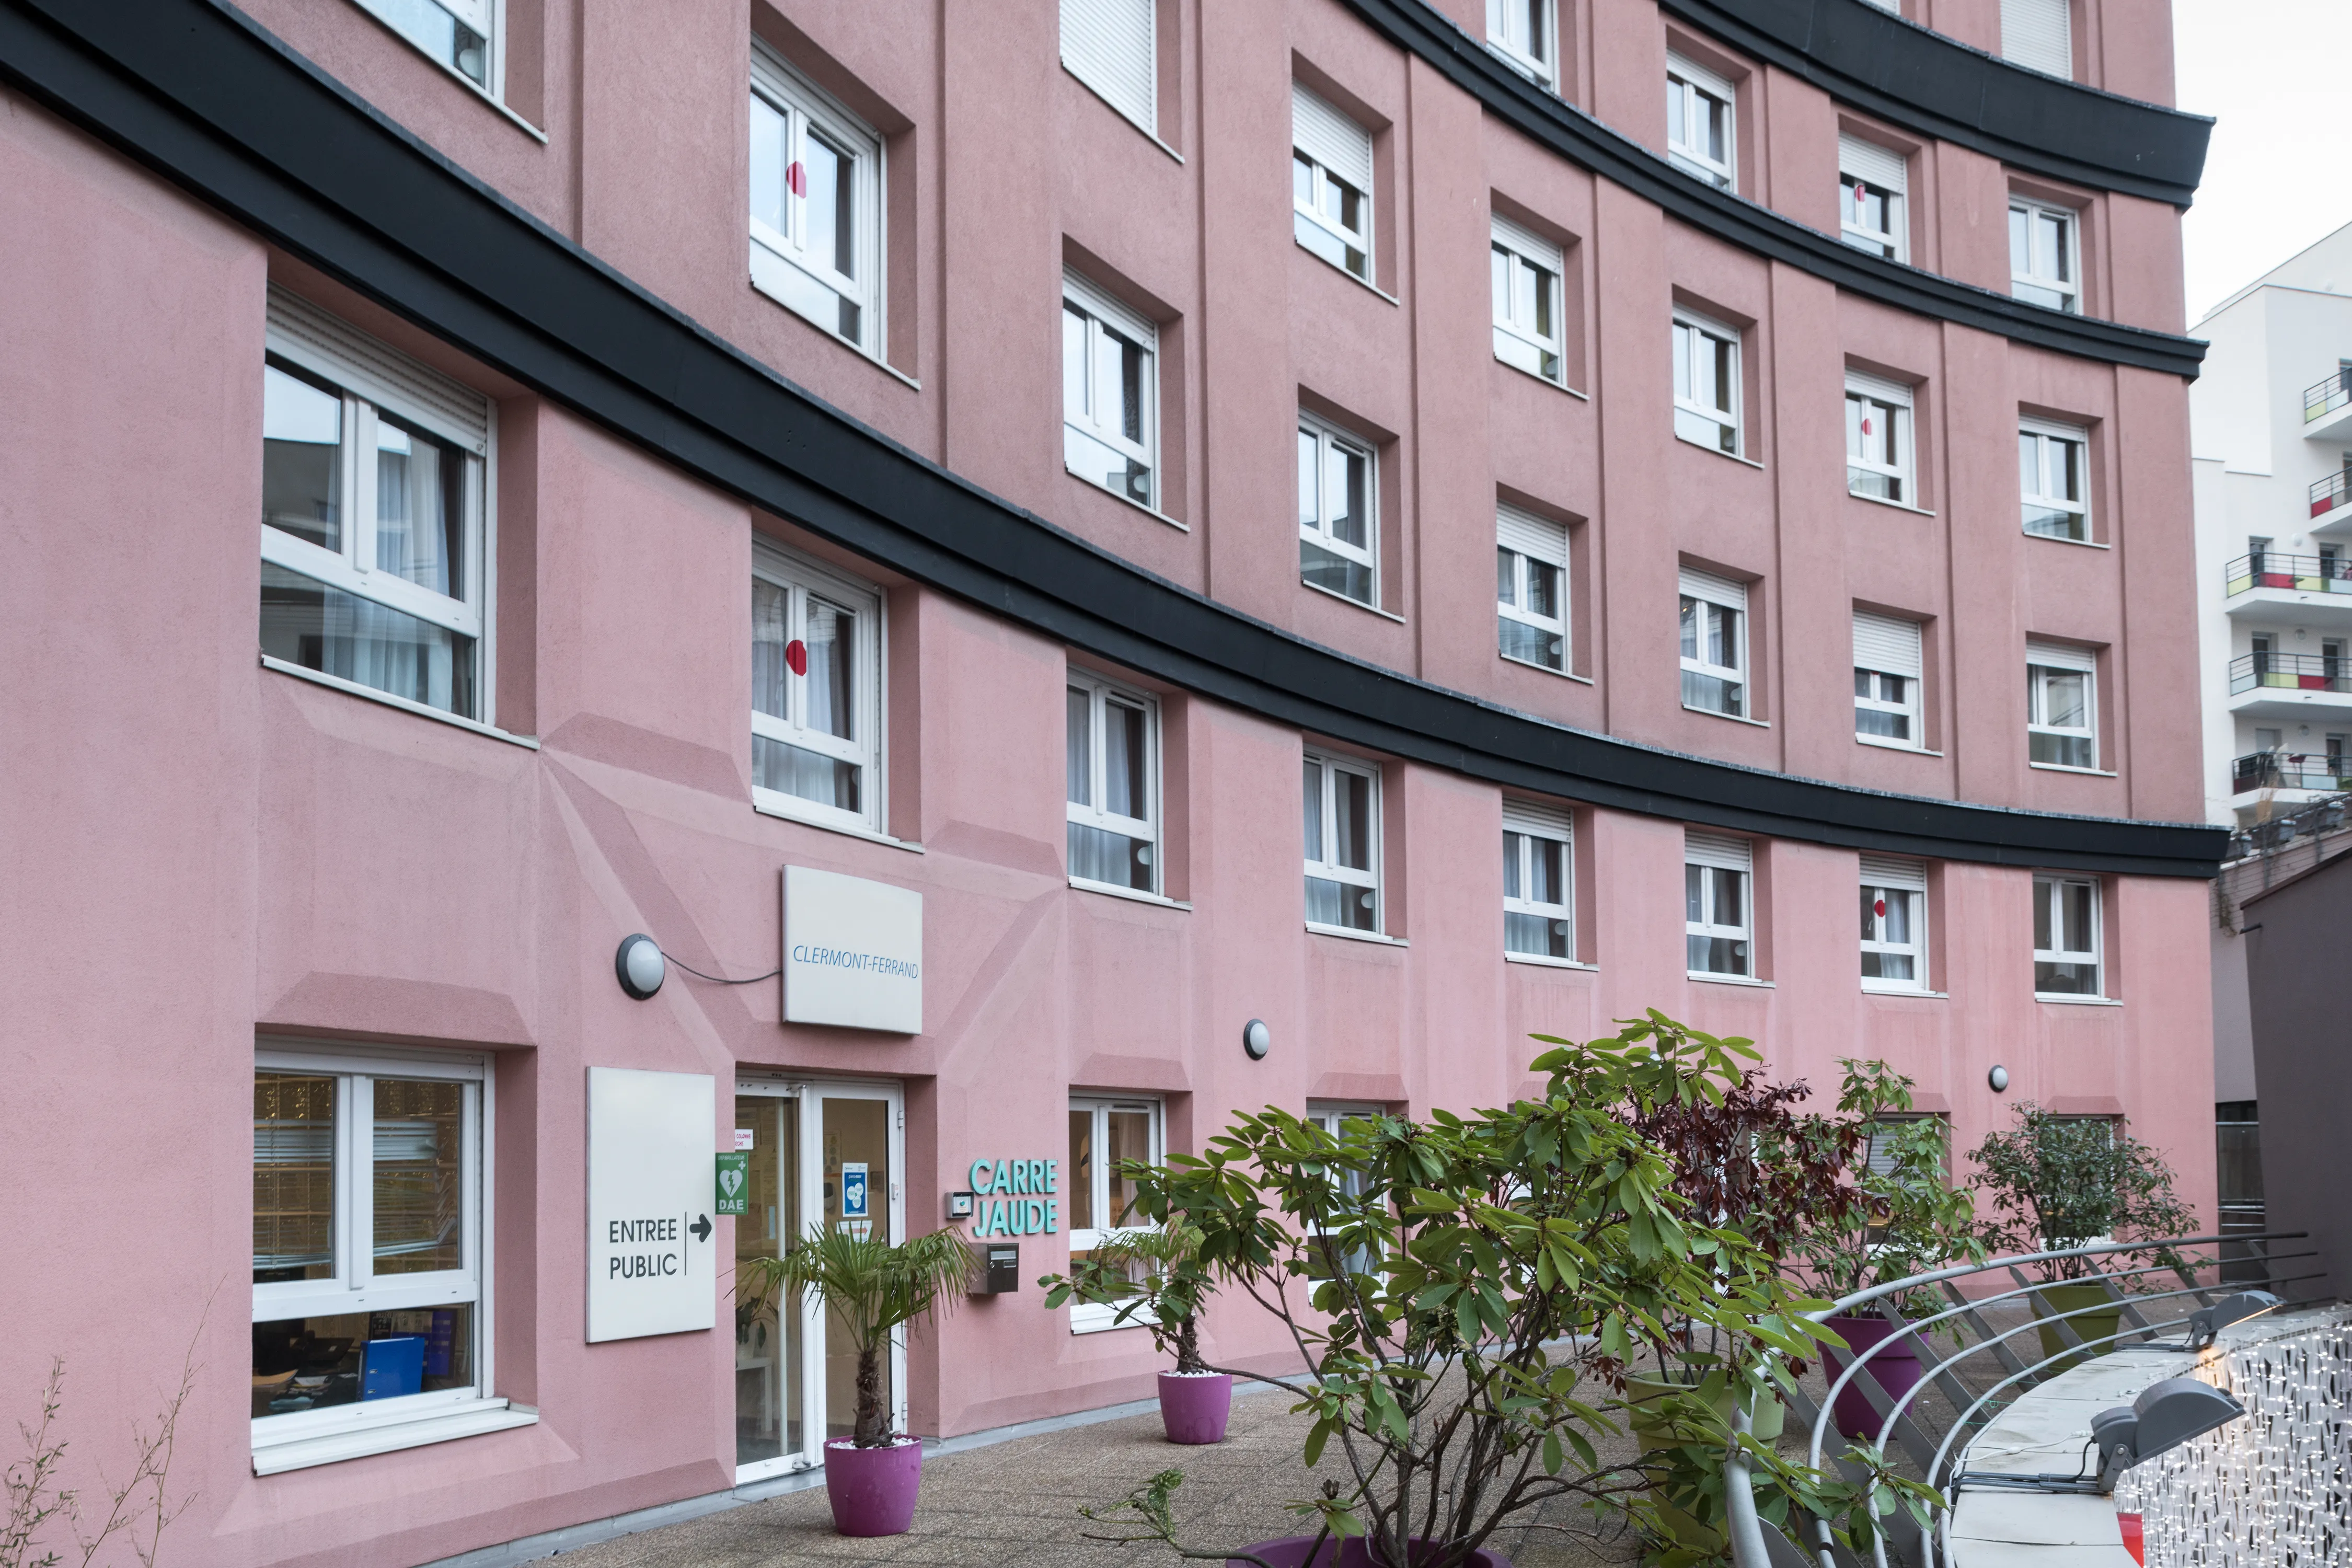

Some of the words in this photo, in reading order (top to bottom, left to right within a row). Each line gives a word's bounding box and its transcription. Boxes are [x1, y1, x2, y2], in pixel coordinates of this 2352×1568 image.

[793, 945, 918, 979] CLERMONT-FERRAND
[969, 1158, 1058, 1195] CARRE
[719, 1199, 744, 1210] DAE
[972, 1200, 1058, 1237] JAUDE
[609, 1218, 677, 1243] ENTREE
[609, 1253, 677, 1279] PUBLIC
